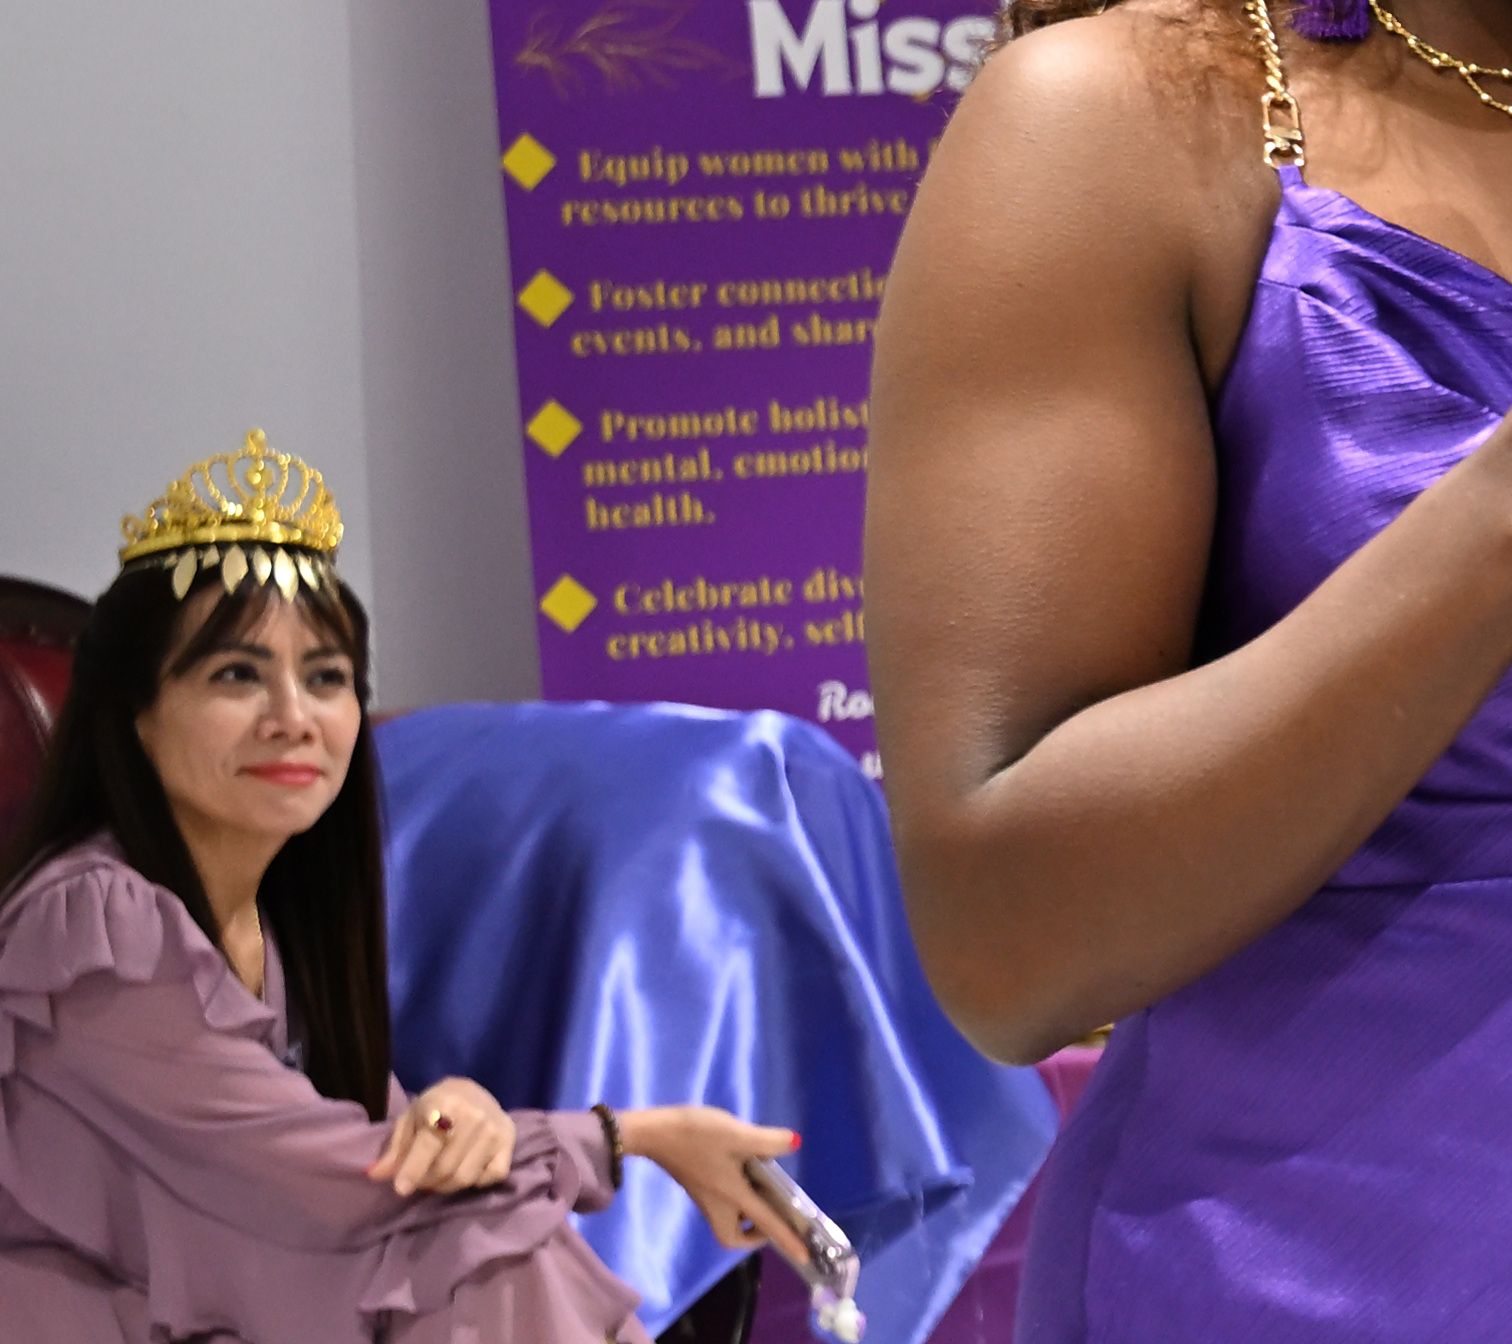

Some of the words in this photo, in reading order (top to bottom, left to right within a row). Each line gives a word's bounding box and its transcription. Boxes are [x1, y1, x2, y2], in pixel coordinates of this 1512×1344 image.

[579, 145, 690, 188] Equip
[700, 149, 829, 176] women
[838, 137, 920, 173] with
[560, 195, 745, 227] resources
[753, 188, 791, 219] to
[800, 181, 909, 218] thrive
[589, 278, 708, 313] Foster
[712, 312, 781, 350] and
[601, 406, 759, 443] Promote
[586, 490, 717, 532] health.
[613, 574, 793, 616] Celebrate
[816, 678, 875, 724] Ro
